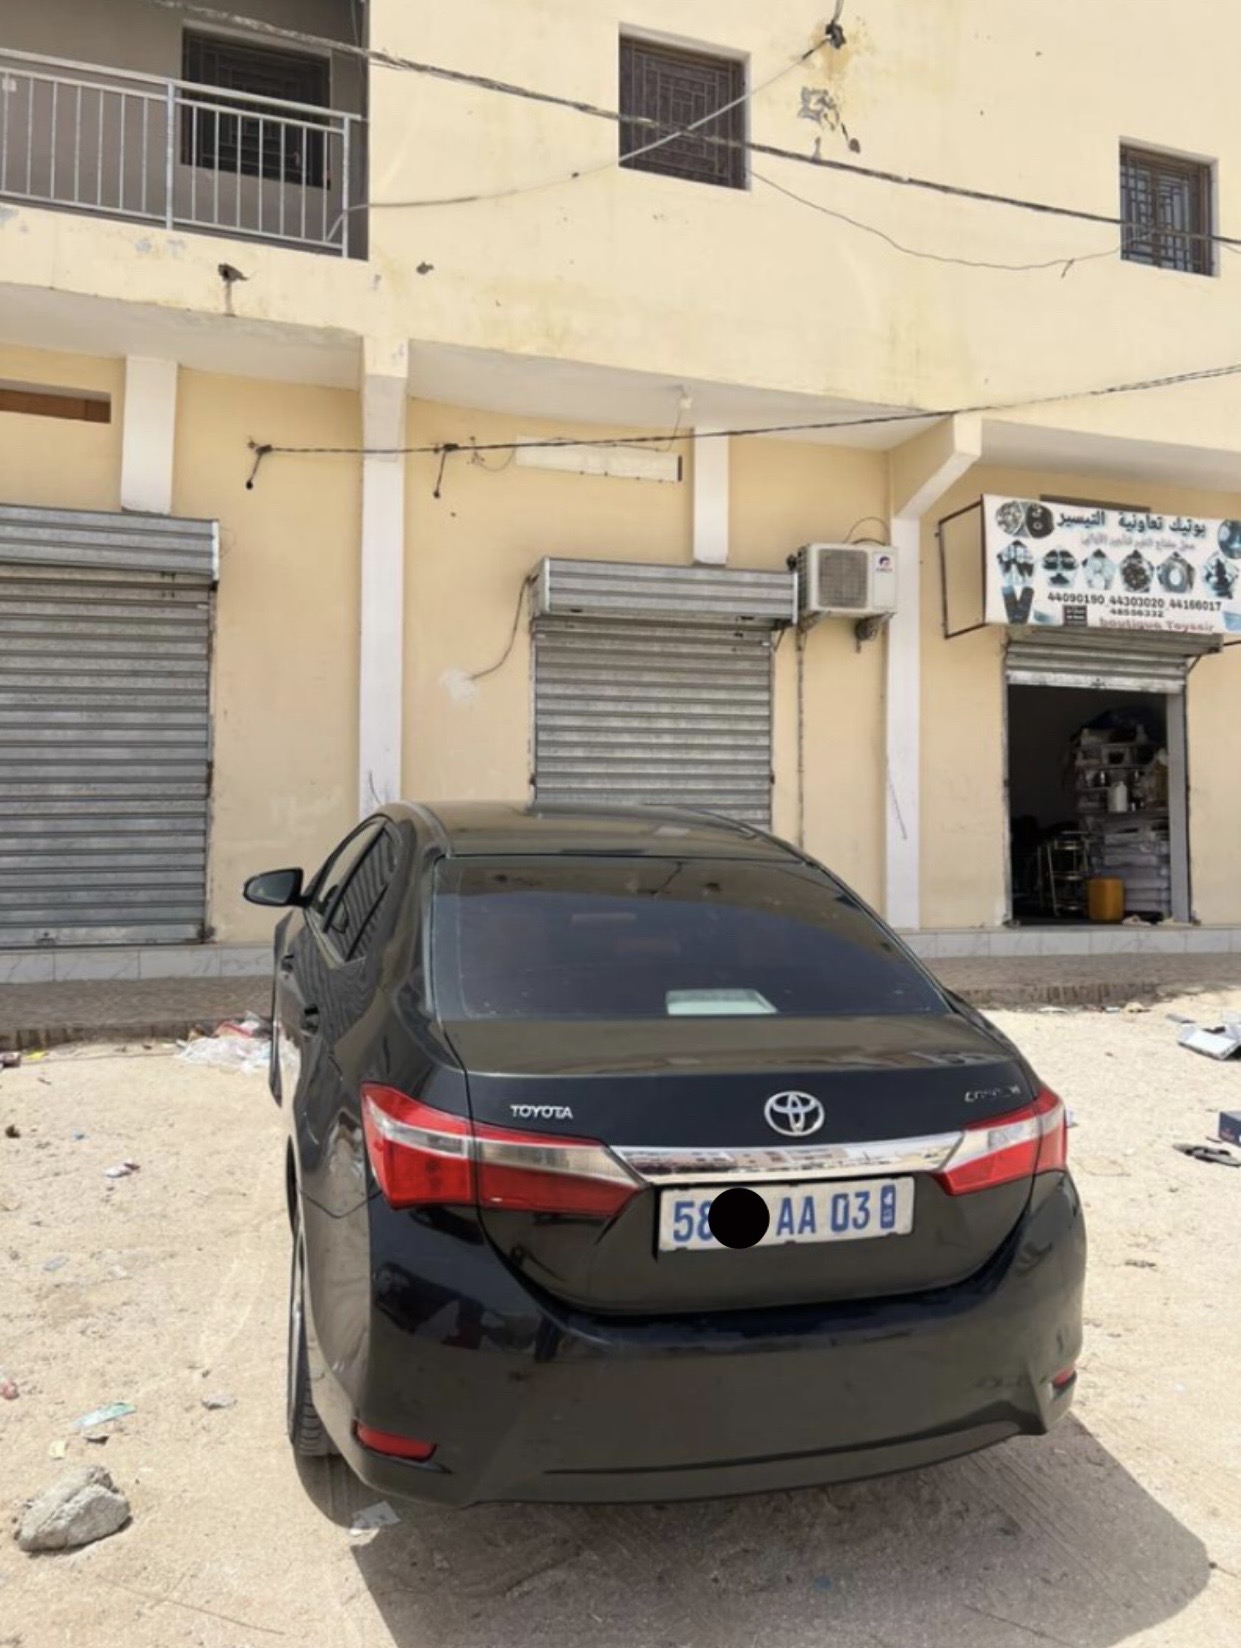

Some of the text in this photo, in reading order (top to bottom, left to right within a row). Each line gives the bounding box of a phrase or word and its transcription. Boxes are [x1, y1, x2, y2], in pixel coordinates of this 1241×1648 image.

[1056, 509, 1207, 538] بوتيك تعاونية التيسير
[510, 1104, 574, 1119] TOYOTA
[776, 1196, 816, 1237] AA
[830, 1191, 870, 1232] 03
